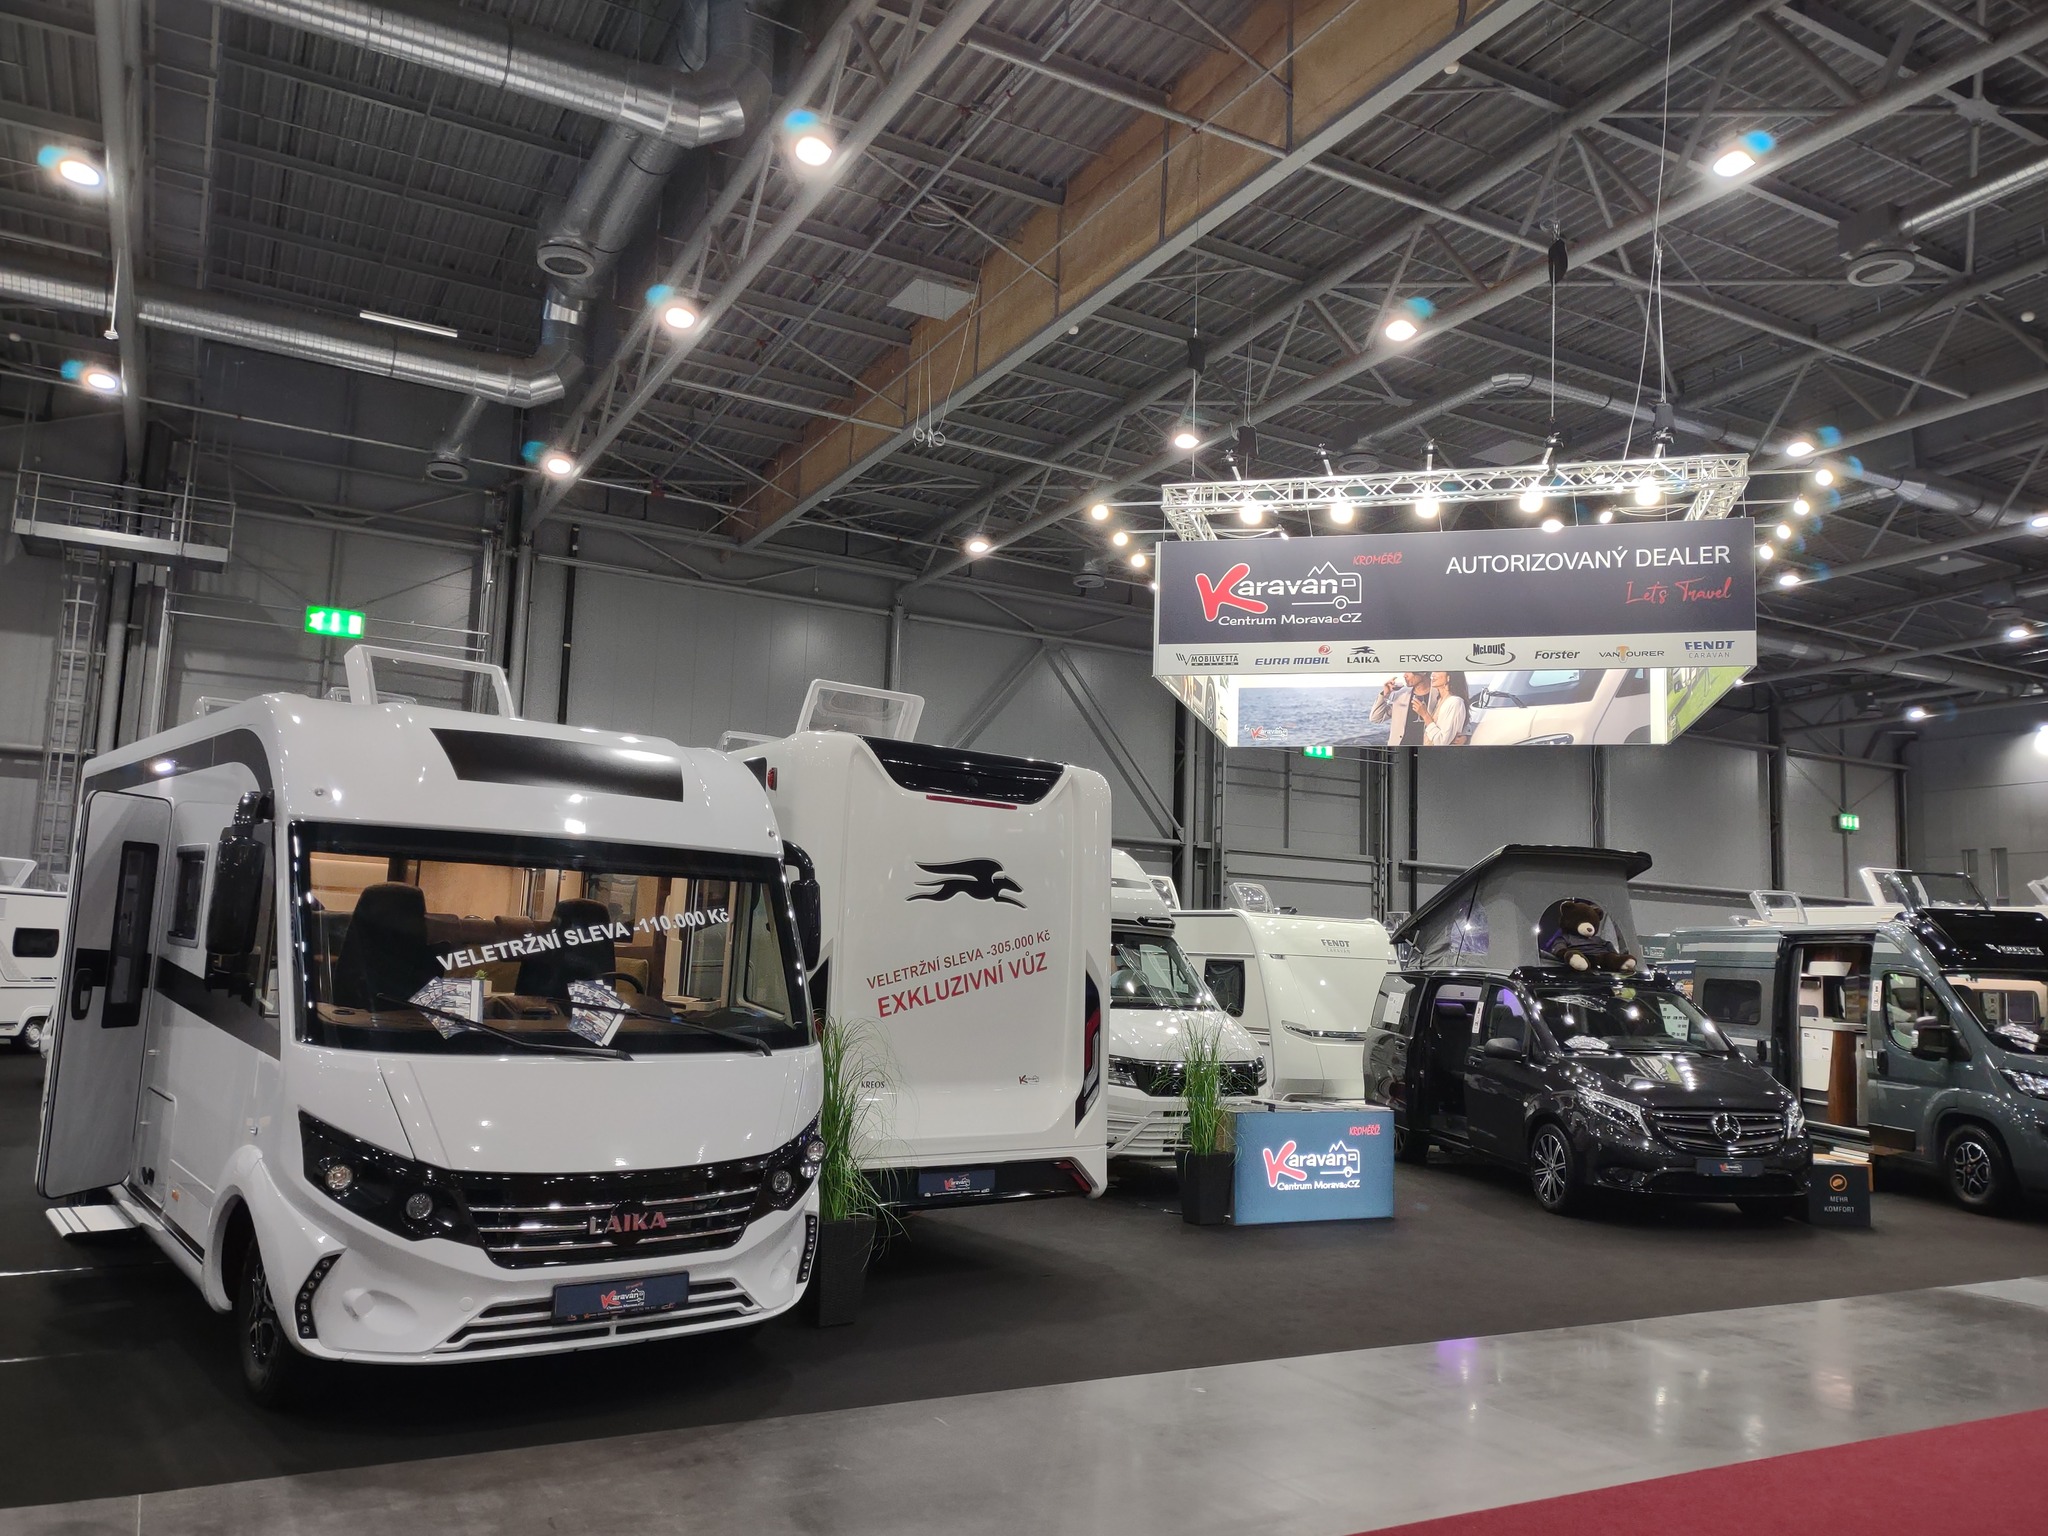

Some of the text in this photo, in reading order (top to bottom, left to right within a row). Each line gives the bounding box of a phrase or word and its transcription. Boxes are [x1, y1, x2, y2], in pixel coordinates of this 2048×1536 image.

[1352, 552, 1403, 566] KROMĚŘÍŽ
[1445, 545, 1731, 575] AUTORIZOVANÝ DEALER
[1195, 563, 1338, 622] Karavan
[1624, 575, 1733, 605] Let's Travel
[1218, 612, 1363, 626] Centrum Morava.CZ
[1684, 640, 1735, 650] FENDT
[1190, 654, 1239, 663] MOBILVETTA
[1254, 656, 1330, 666] EURA MOBIL
[1346, 656, 1381, 664] LAIKA
[1534, 649, 1580, 660] Forster
[1599, 646, 1665, 663] VANTOURER
[1688, 651, 1730, 659] CARAVAN
[435, 907, 731, 971] VELETRŽNÍ SLEVA -110.000 Kč
[1320, 938, 1351, 948] FENDT
[866, 929, 1051, 990] VELETRŽNÍ SLEVA -305.000 Kč
[877, 951, 1048, 1018] EXKLUZIVNÍ VŮZ
[861, 1080, 886, 1089] KREOS
[1277, 1179, 1361, 1191] Centrum Morava.CZ
[1829, 1195, 1849, 1203] MEHR
[589, 1211, 668, 1235] LAIKA
